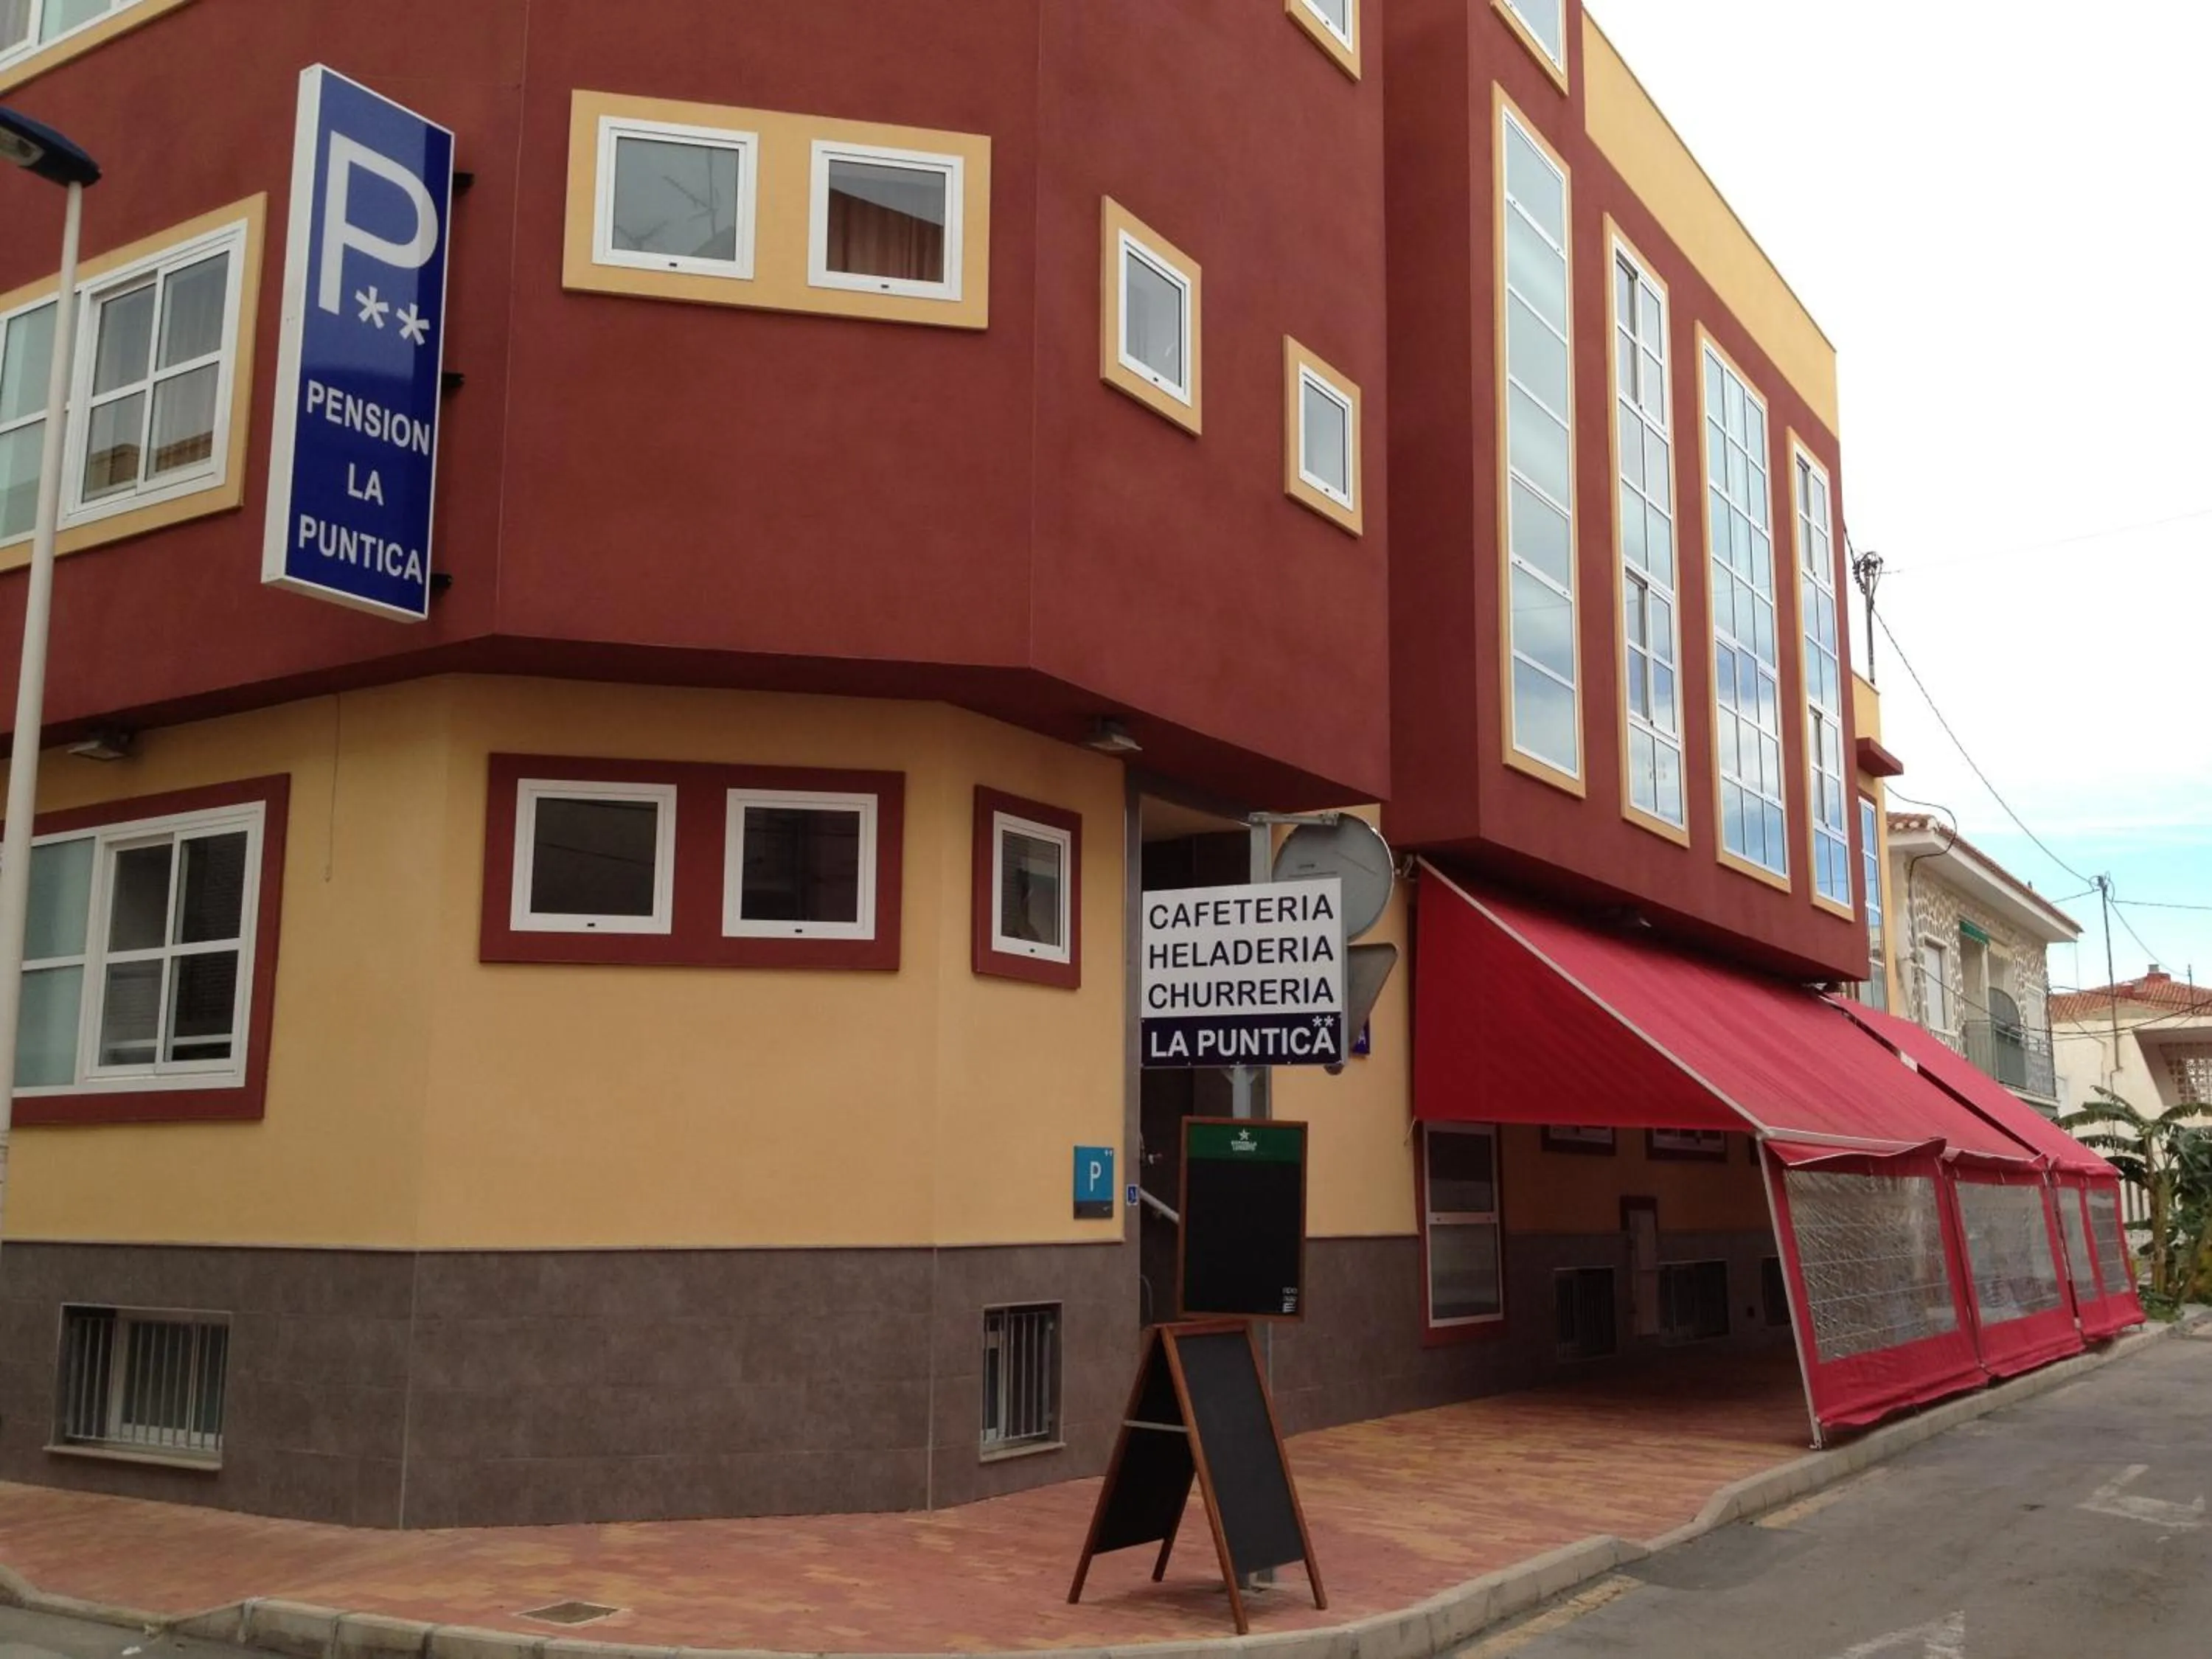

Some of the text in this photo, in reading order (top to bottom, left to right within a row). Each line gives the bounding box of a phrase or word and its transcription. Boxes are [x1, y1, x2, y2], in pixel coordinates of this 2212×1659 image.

[319, 130, 438, 315] P
[307, 380, 430, 456] PENSION
[347, 462, 383, 505] LA
[299, 514, 422, 584] PUNTICA
[1150, 894, 1334, 929] CAFETERIA
[1150, 935, 1334, 969] HELADERIA
[1149, 977, 1334, 1009] CHURRERIA
[1151, 1027, 1335, 1057] LA PUNTICA
[1090, 1161, 1102, 1192] P
